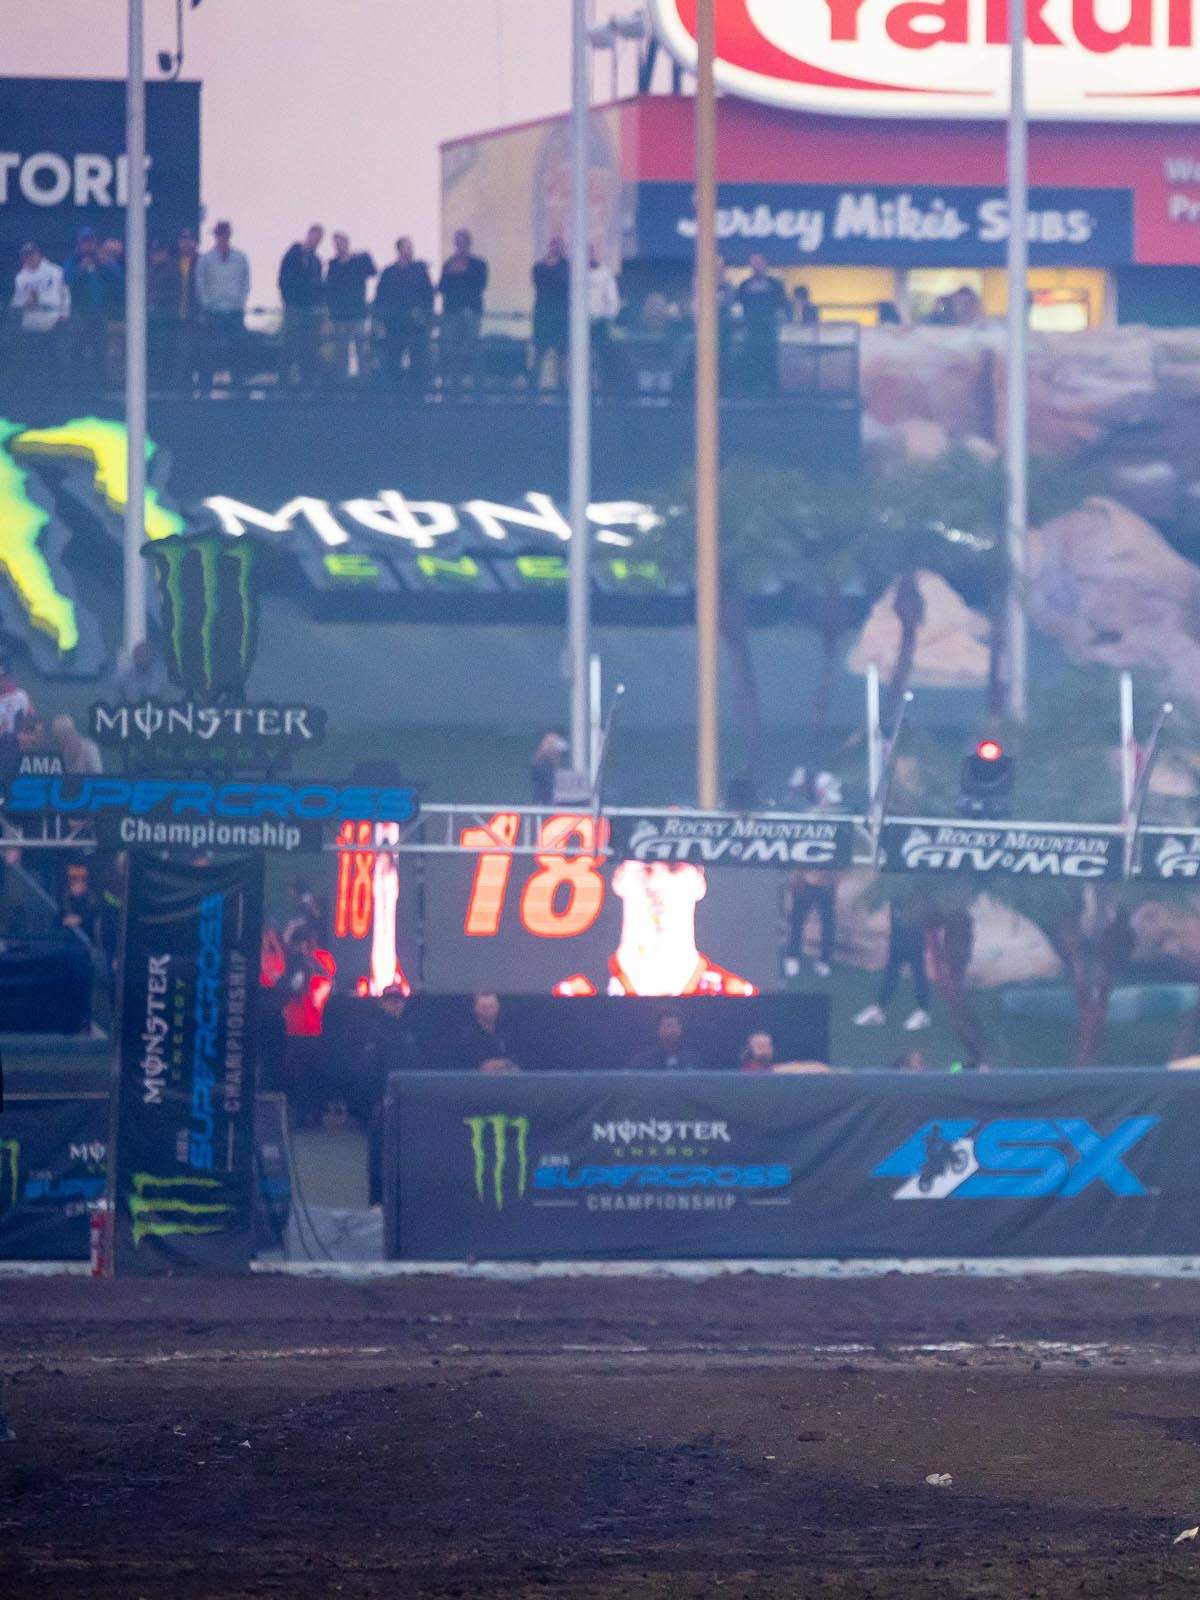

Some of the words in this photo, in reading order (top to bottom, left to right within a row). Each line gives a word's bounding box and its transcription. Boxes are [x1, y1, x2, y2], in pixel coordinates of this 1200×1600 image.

[93, 702, 314, 740] MONSTER
[19, 756, 64, 775] AMA
[119, 817, 301, 851] Championship
[335, 820, 374, 939] 18
[461, 812, 610, 937] 18
[142, 952, 172, 1105] MONSTER
[592, 1117, 731, 1144] MONSTER
